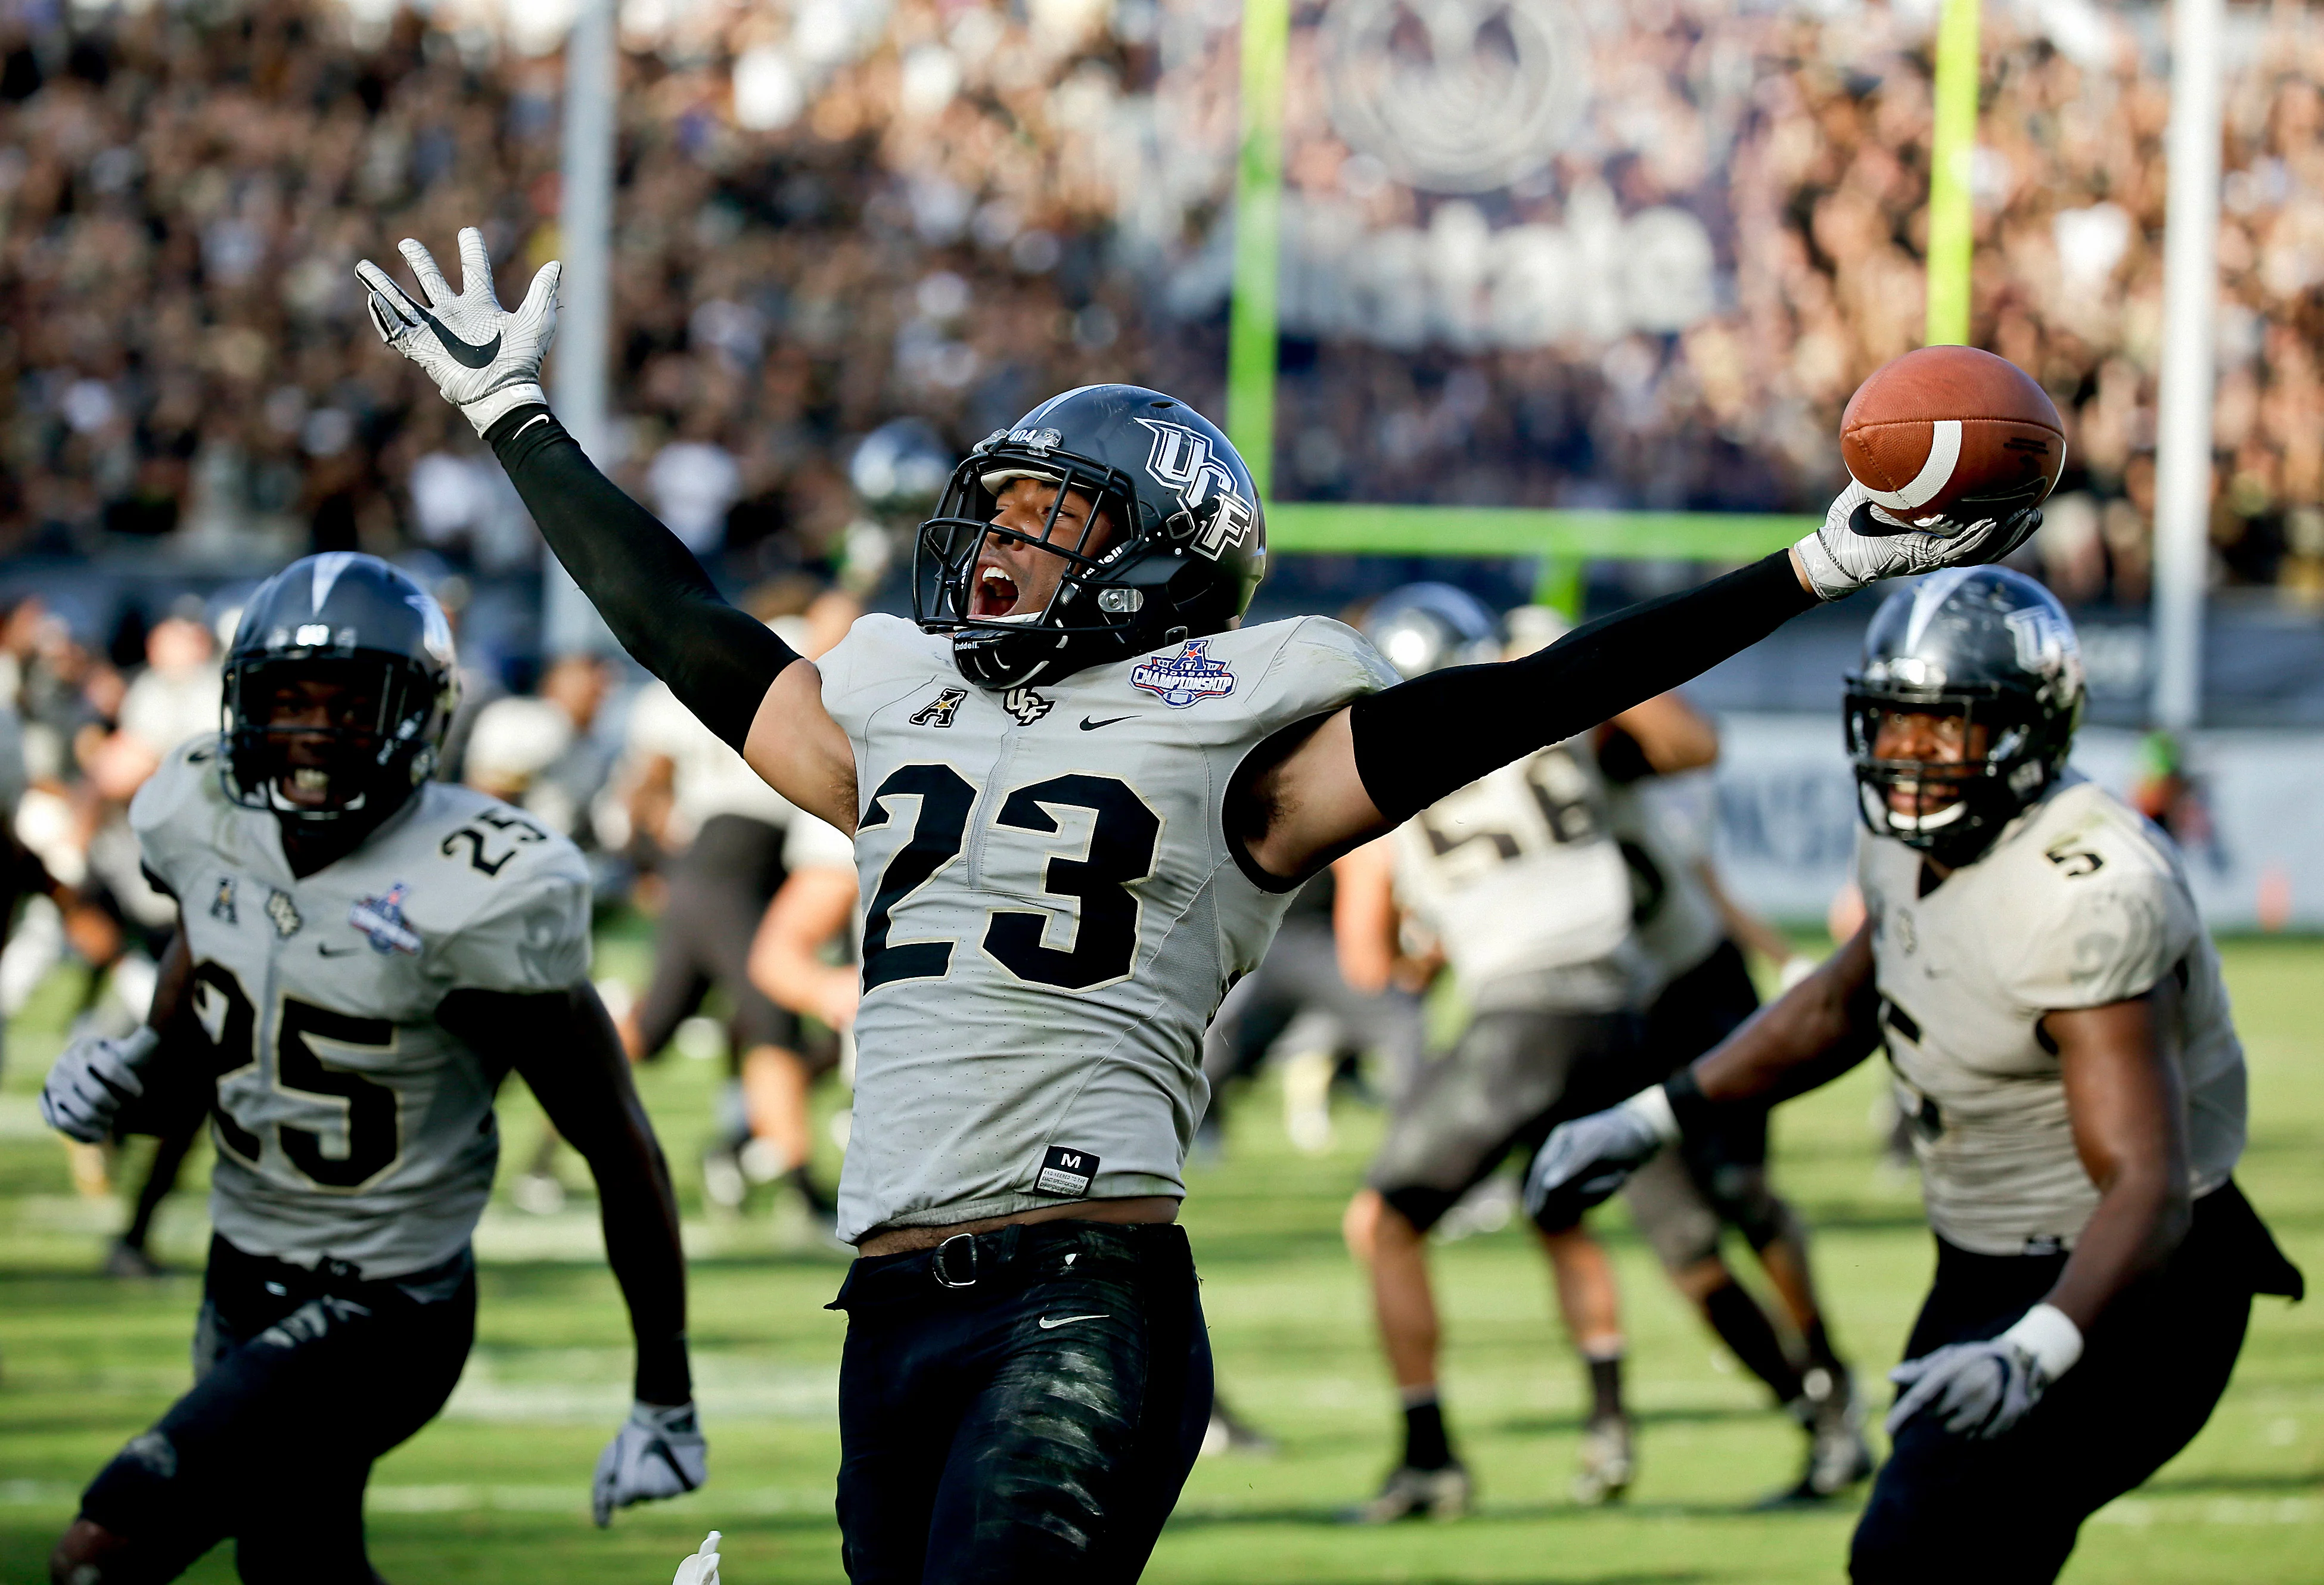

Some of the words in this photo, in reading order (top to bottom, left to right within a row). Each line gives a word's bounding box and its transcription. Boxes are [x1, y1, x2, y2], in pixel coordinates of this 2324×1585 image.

[1133, 417, 1254, 561] UCF
[1133, 668, 1232, 691] CHAMPIONSHIP
[1152, 666, 1219, 676] FOOTBALL
[1003, 688, 1056, 726] UCF
[440, 807, 547, 877] 25
[2044, 836, 2103, 877] 5
[855, 760, 1167, 997] 23
[192, 958, 402, 1189] 25
[1061, 1153, 1082, 1168] M
